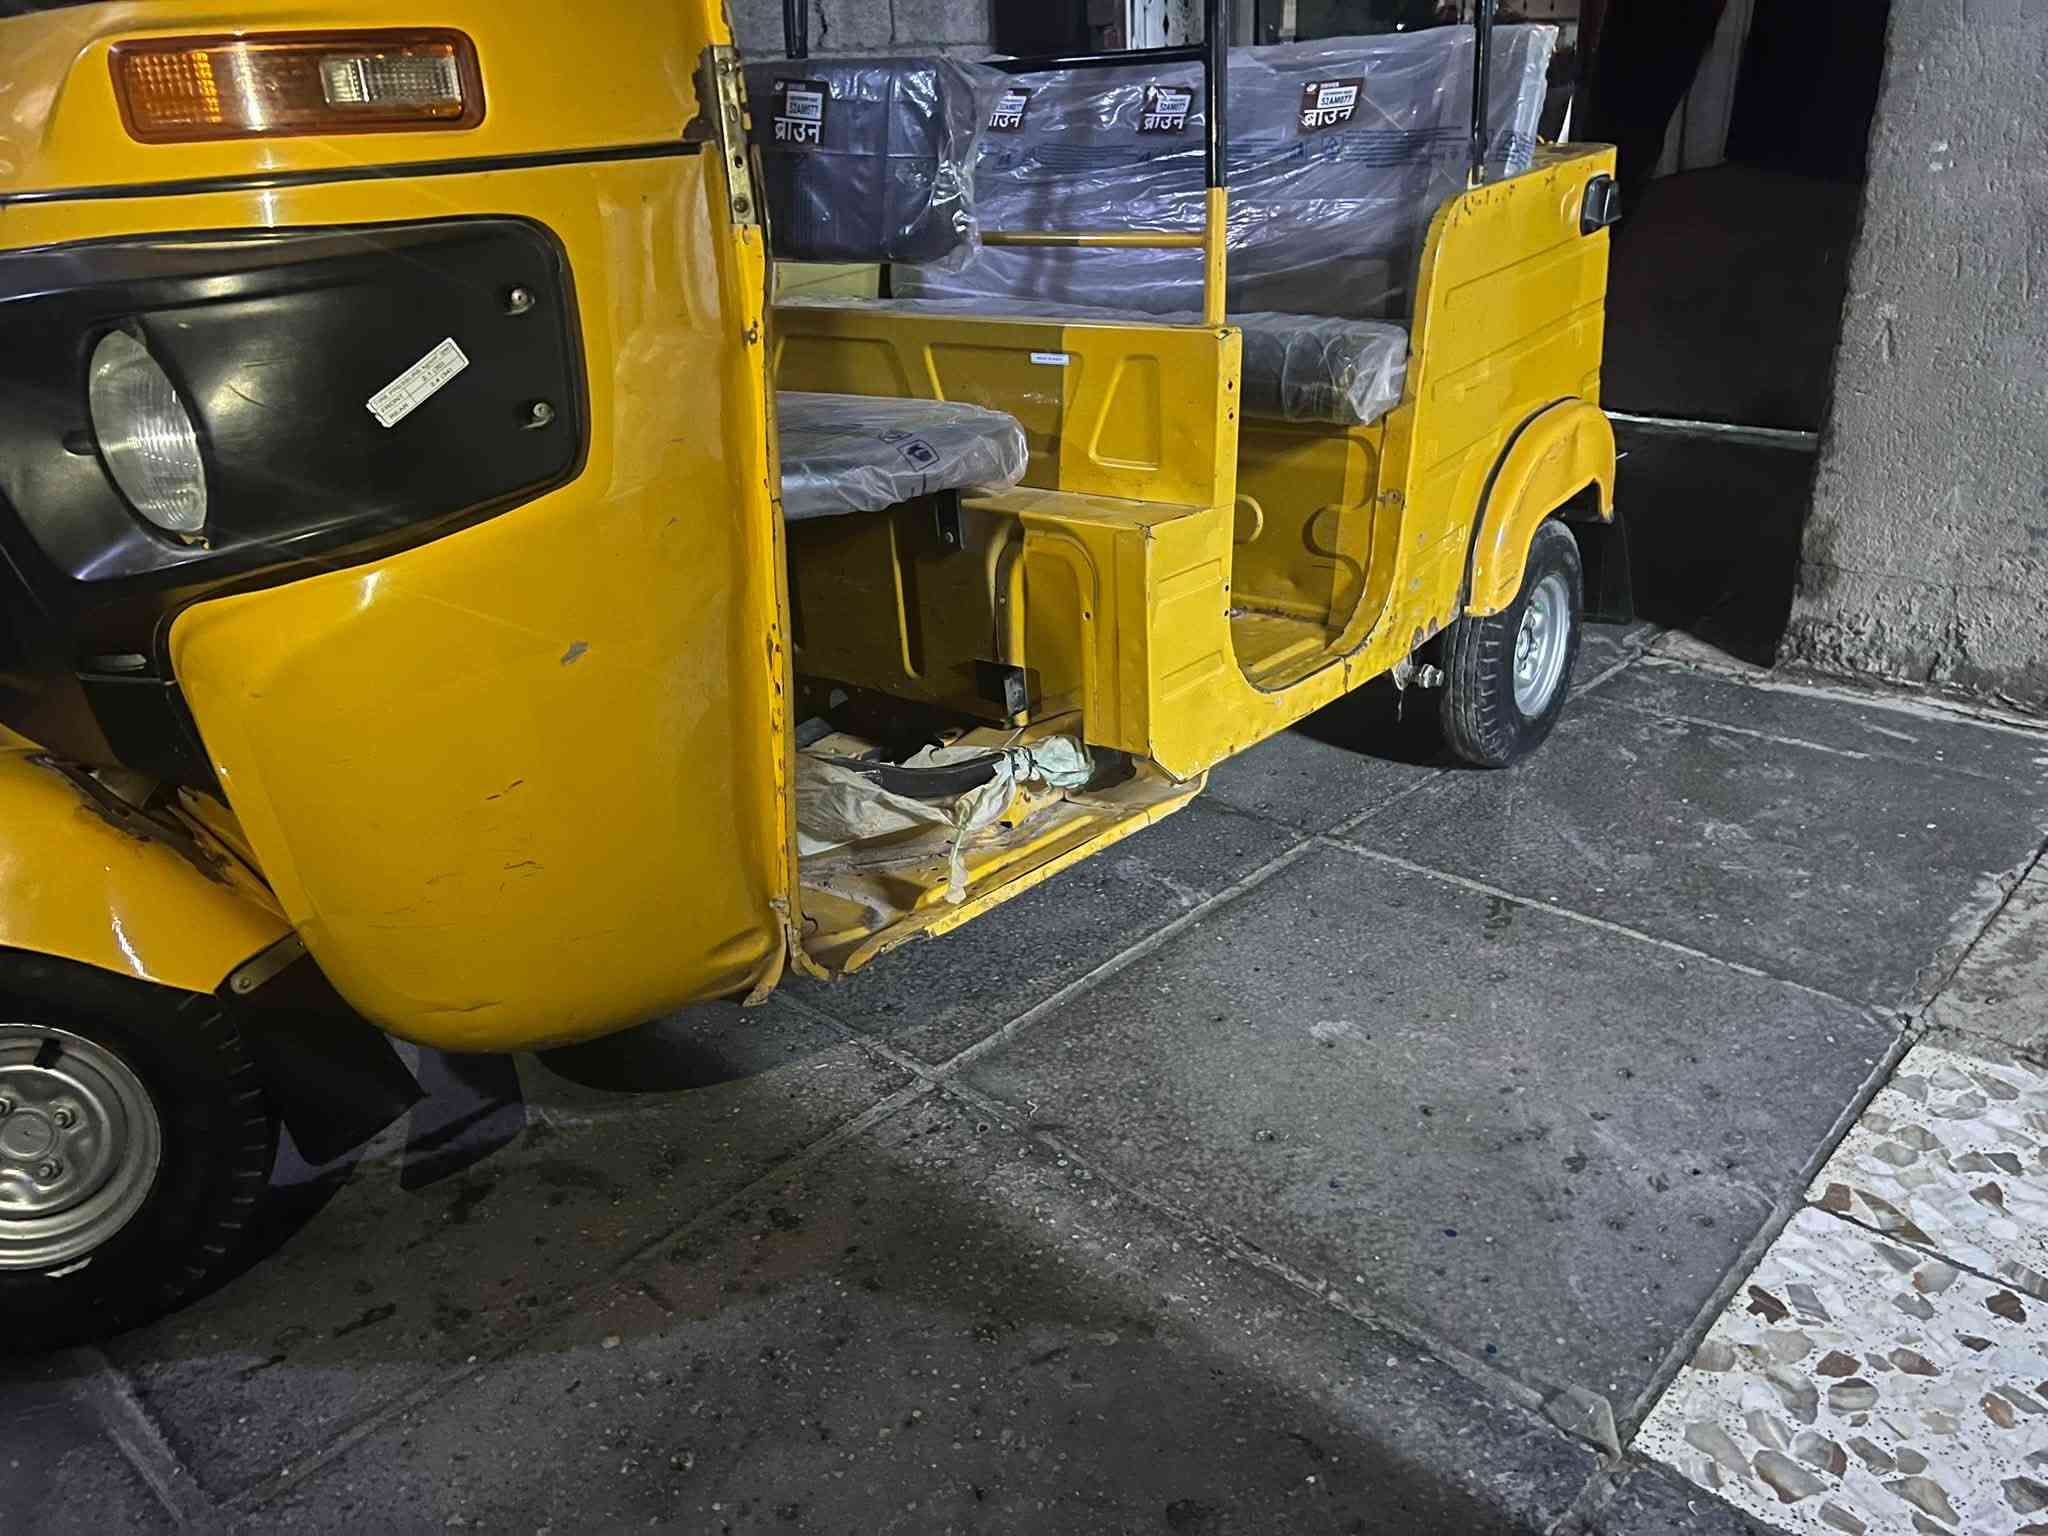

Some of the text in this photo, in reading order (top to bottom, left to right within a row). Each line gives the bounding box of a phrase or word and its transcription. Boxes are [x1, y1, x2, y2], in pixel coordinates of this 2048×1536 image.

[1144, 113, 1186, 130] ब्राउन
[1301, 105, 1355, 126] ब्राउन
[774, 116, 822, 144] ब्राउन
